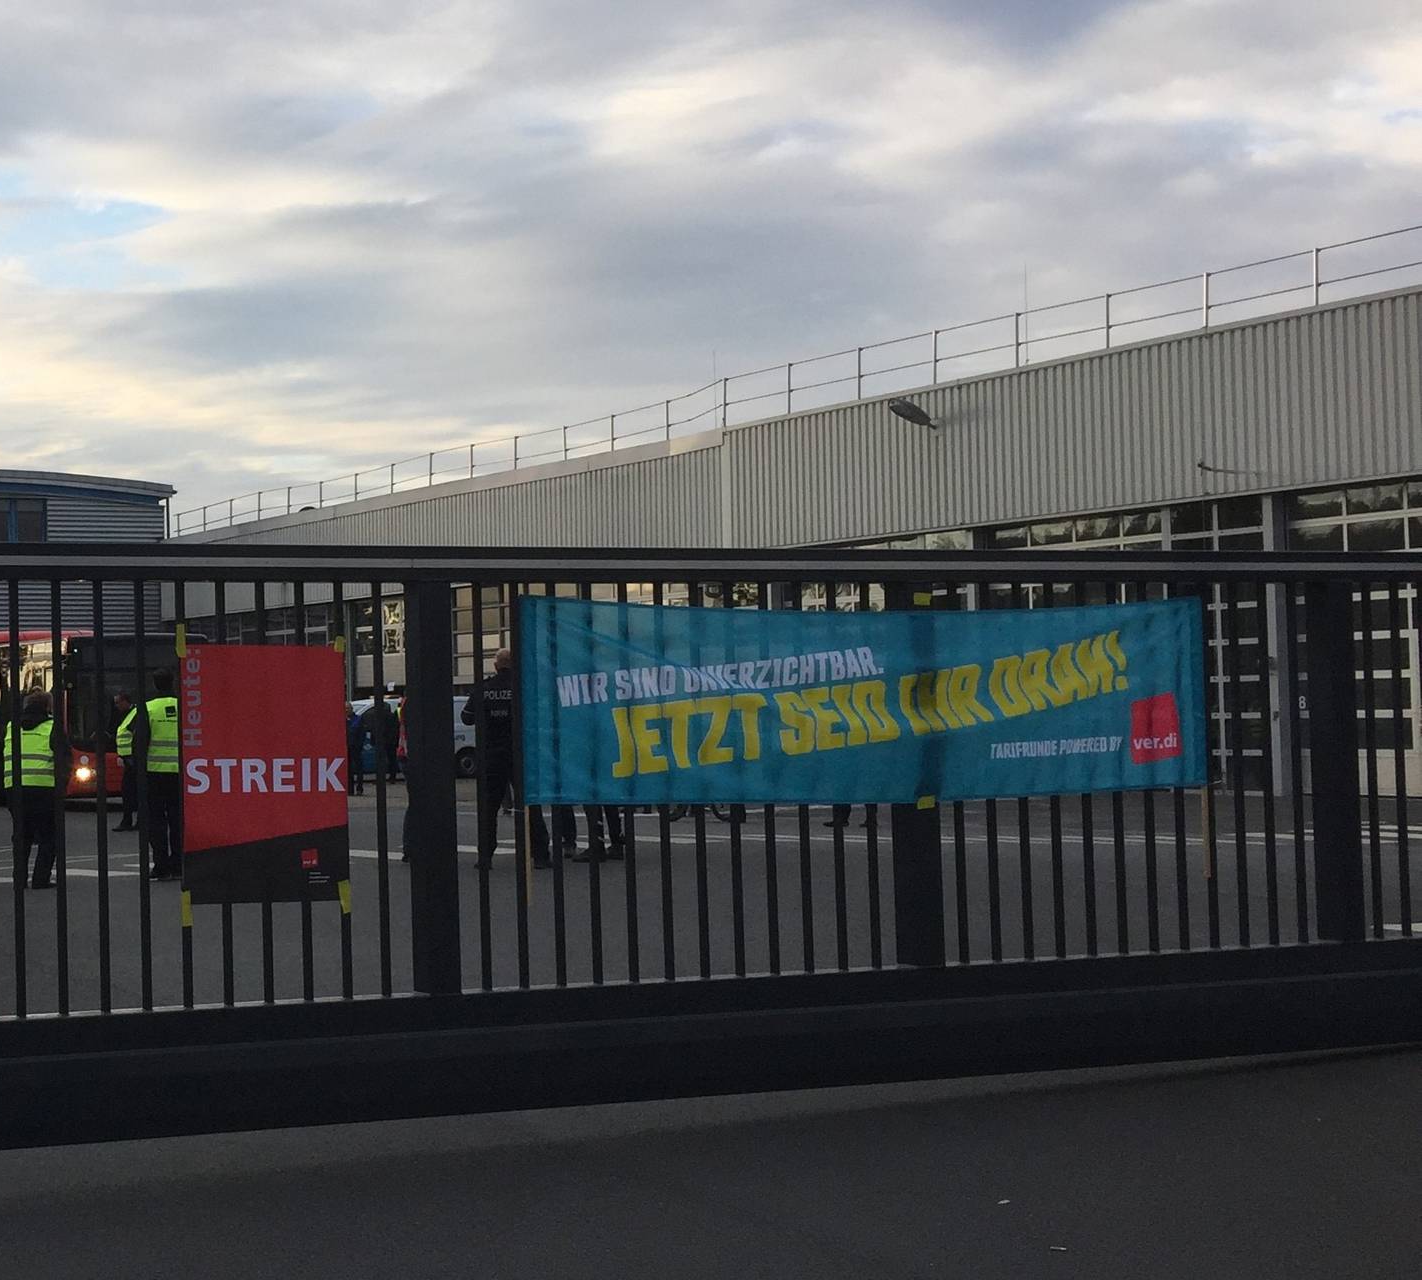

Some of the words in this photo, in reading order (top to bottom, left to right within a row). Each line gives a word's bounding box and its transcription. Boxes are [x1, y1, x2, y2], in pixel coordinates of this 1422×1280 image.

[556, 672, 608, 707] WIR
[615, 665, 676, 700] SIND
[681, 646, 884, 693] UNVERZICHTBAR.
[183, 648, 202, 747] Heute:
[612, 692, 766, 778] JETZT
[774, 680, 900, 755] SEID
[899, 664, 994, 736] IHR
[988, 630, 1129, 718] DRAN!
[1298, 695, 1307, 709] 8
[990, 740, 1058, 759] TARIFRUNDE
[1059, 736, 1107, 756] POWERED
[1109, 736, 1123, 752] BY
[1133, 732, 1178, 751] ver.di
[186, 757, 345, 794] STREIK
